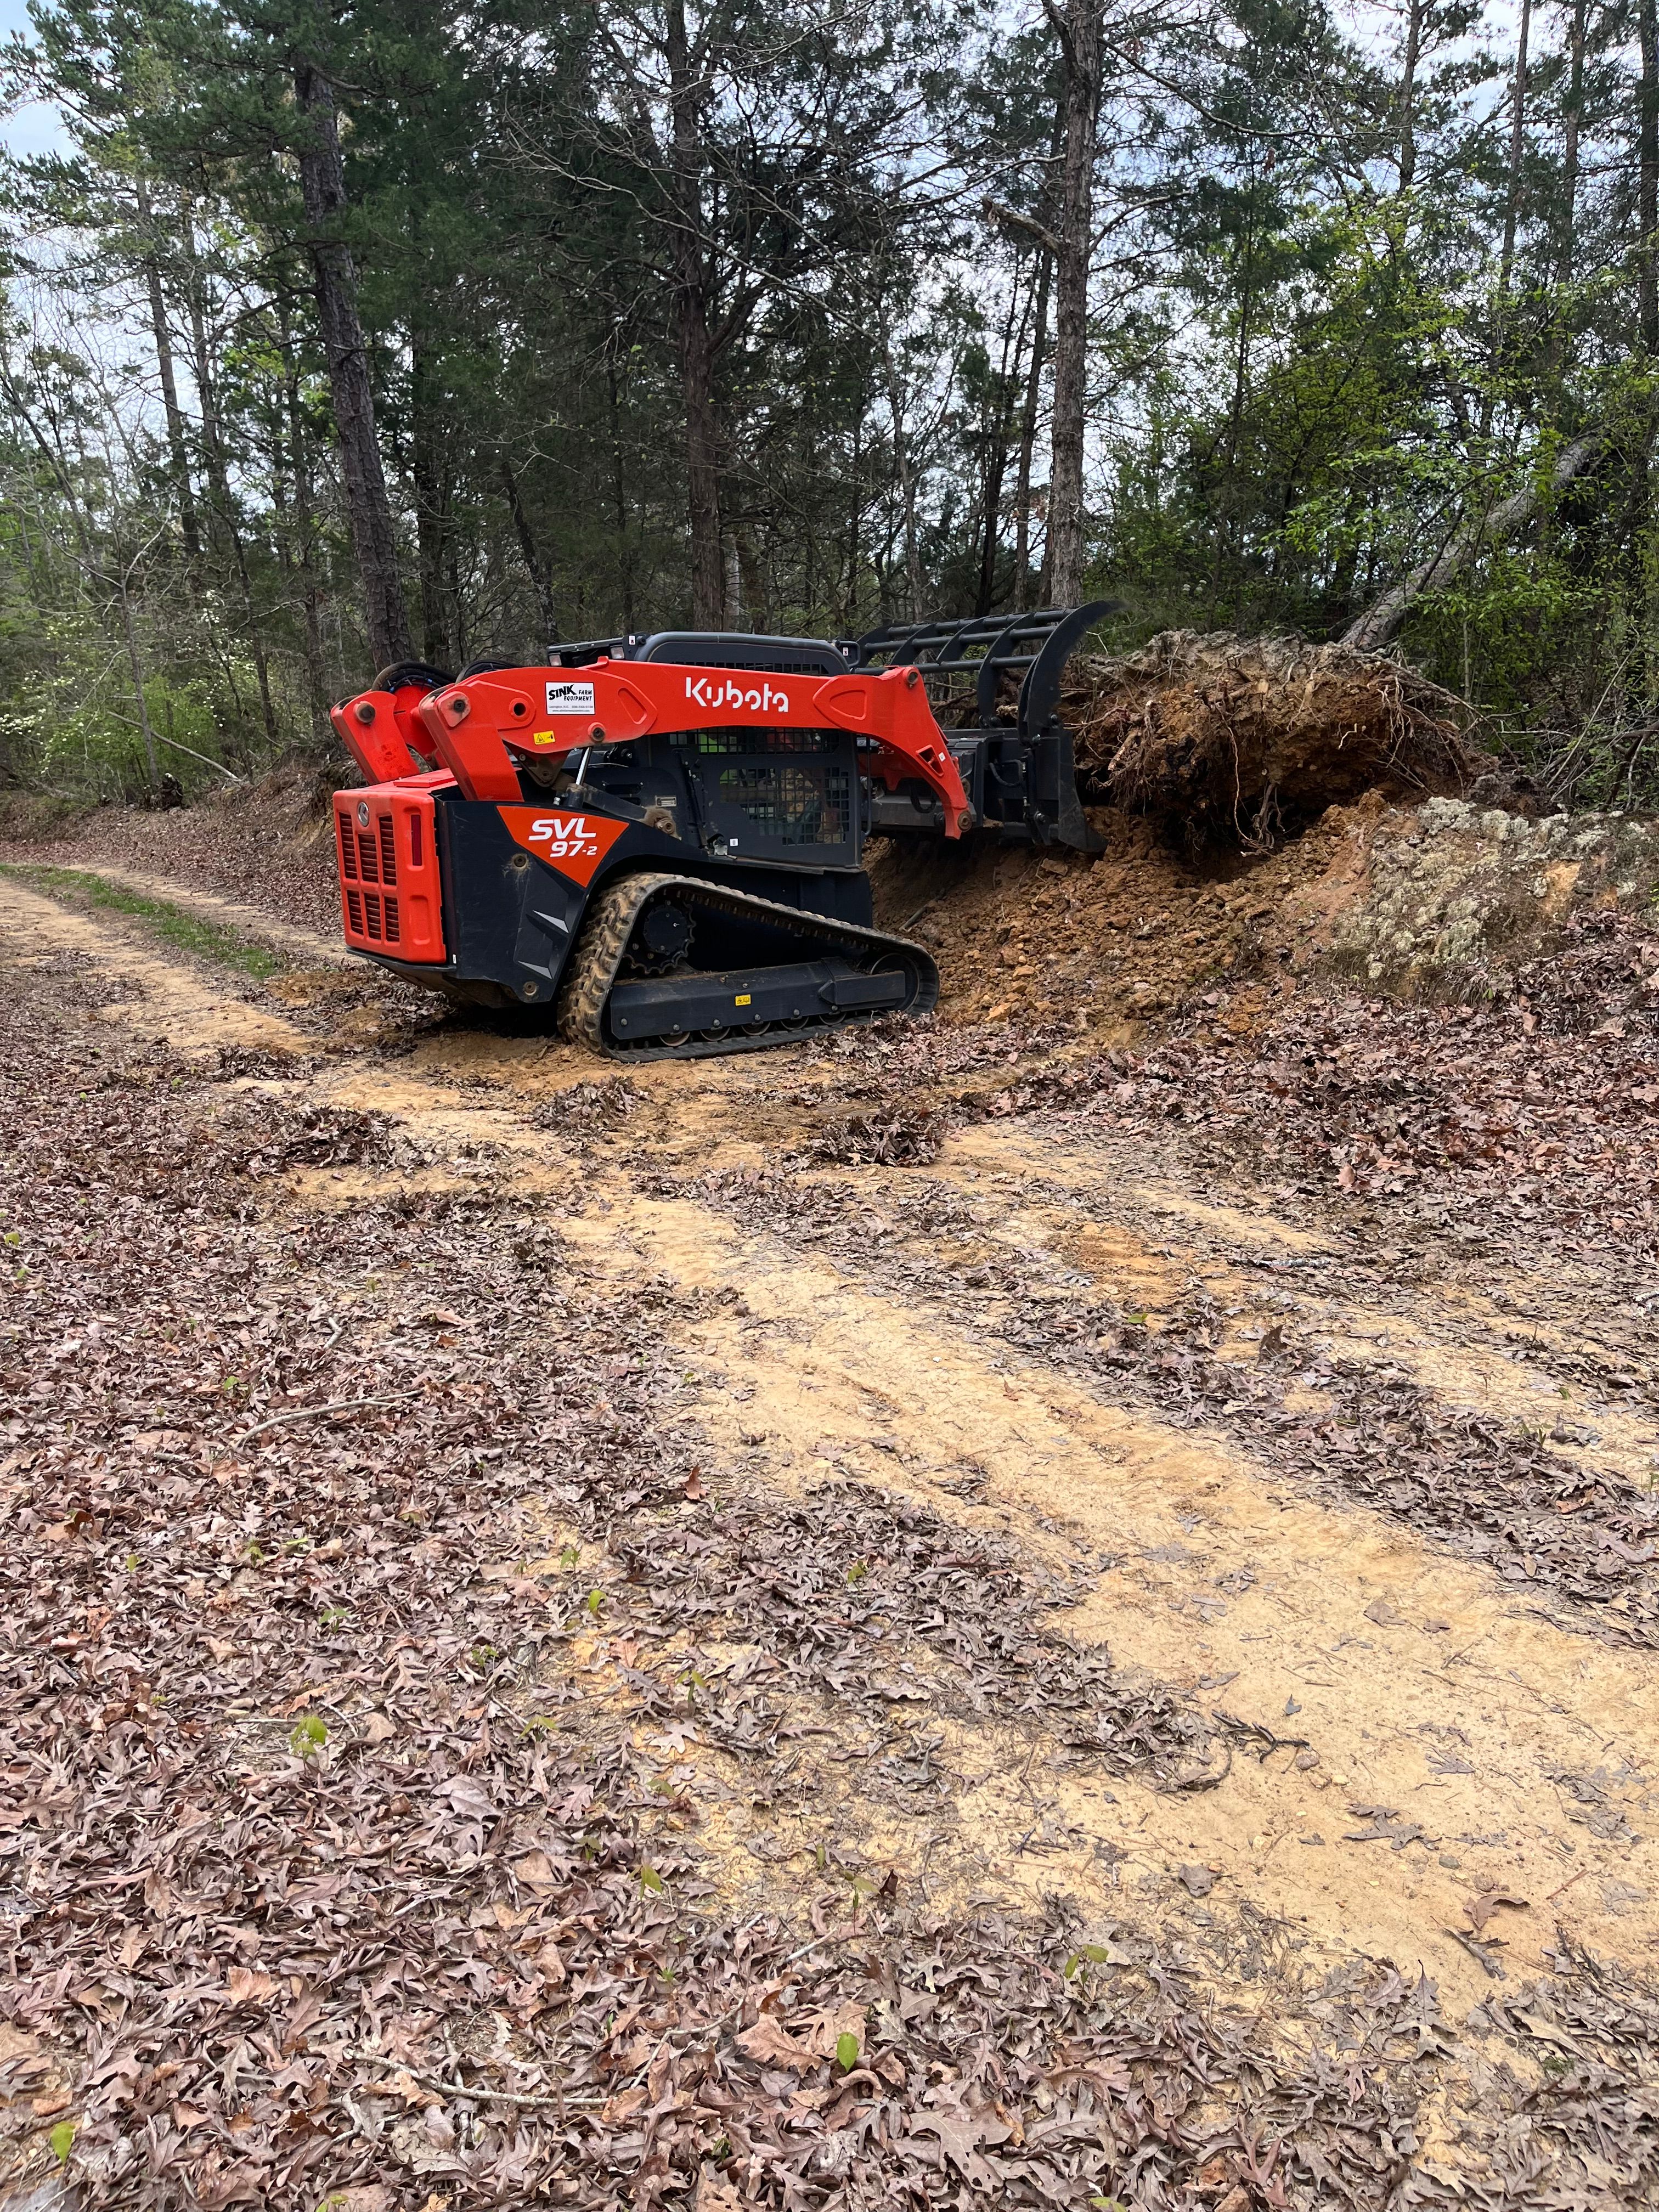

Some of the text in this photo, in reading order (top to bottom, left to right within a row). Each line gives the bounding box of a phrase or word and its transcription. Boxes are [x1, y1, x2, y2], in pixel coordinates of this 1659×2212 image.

[549, 684, 577, 701] SINK
[686, 676, 789, 713] Kubota
[528, 817, 596, 840] SVL
[550, 840, 597, 857] 97-2
